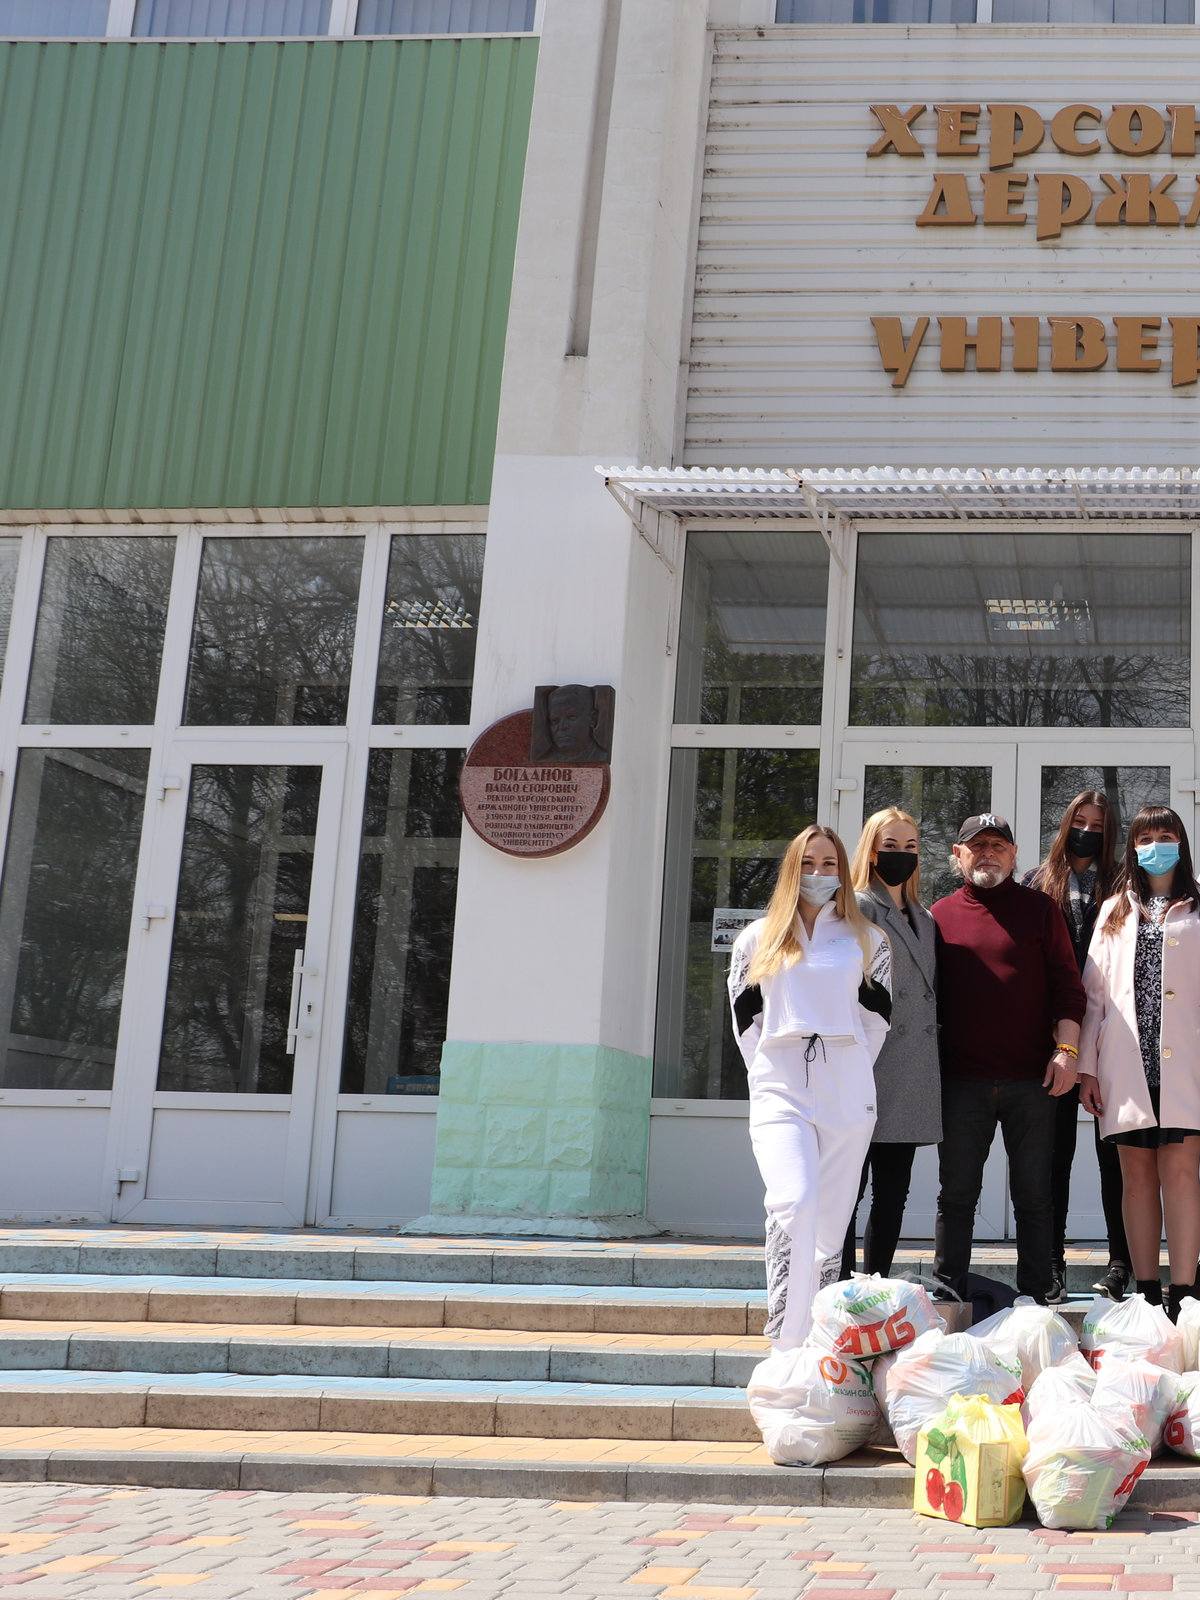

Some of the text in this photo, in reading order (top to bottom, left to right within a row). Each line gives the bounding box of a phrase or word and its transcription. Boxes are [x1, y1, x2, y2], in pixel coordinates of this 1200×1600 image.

[493, 768, 573, 781] БОГДАНОВ
[485, 783, 519, 793] ПАВЛО
[486, 794, 515, 802] РЕКТОР
[979, 813, 996, 826] NY
[833, 1305, 916, 1356] АТБ
